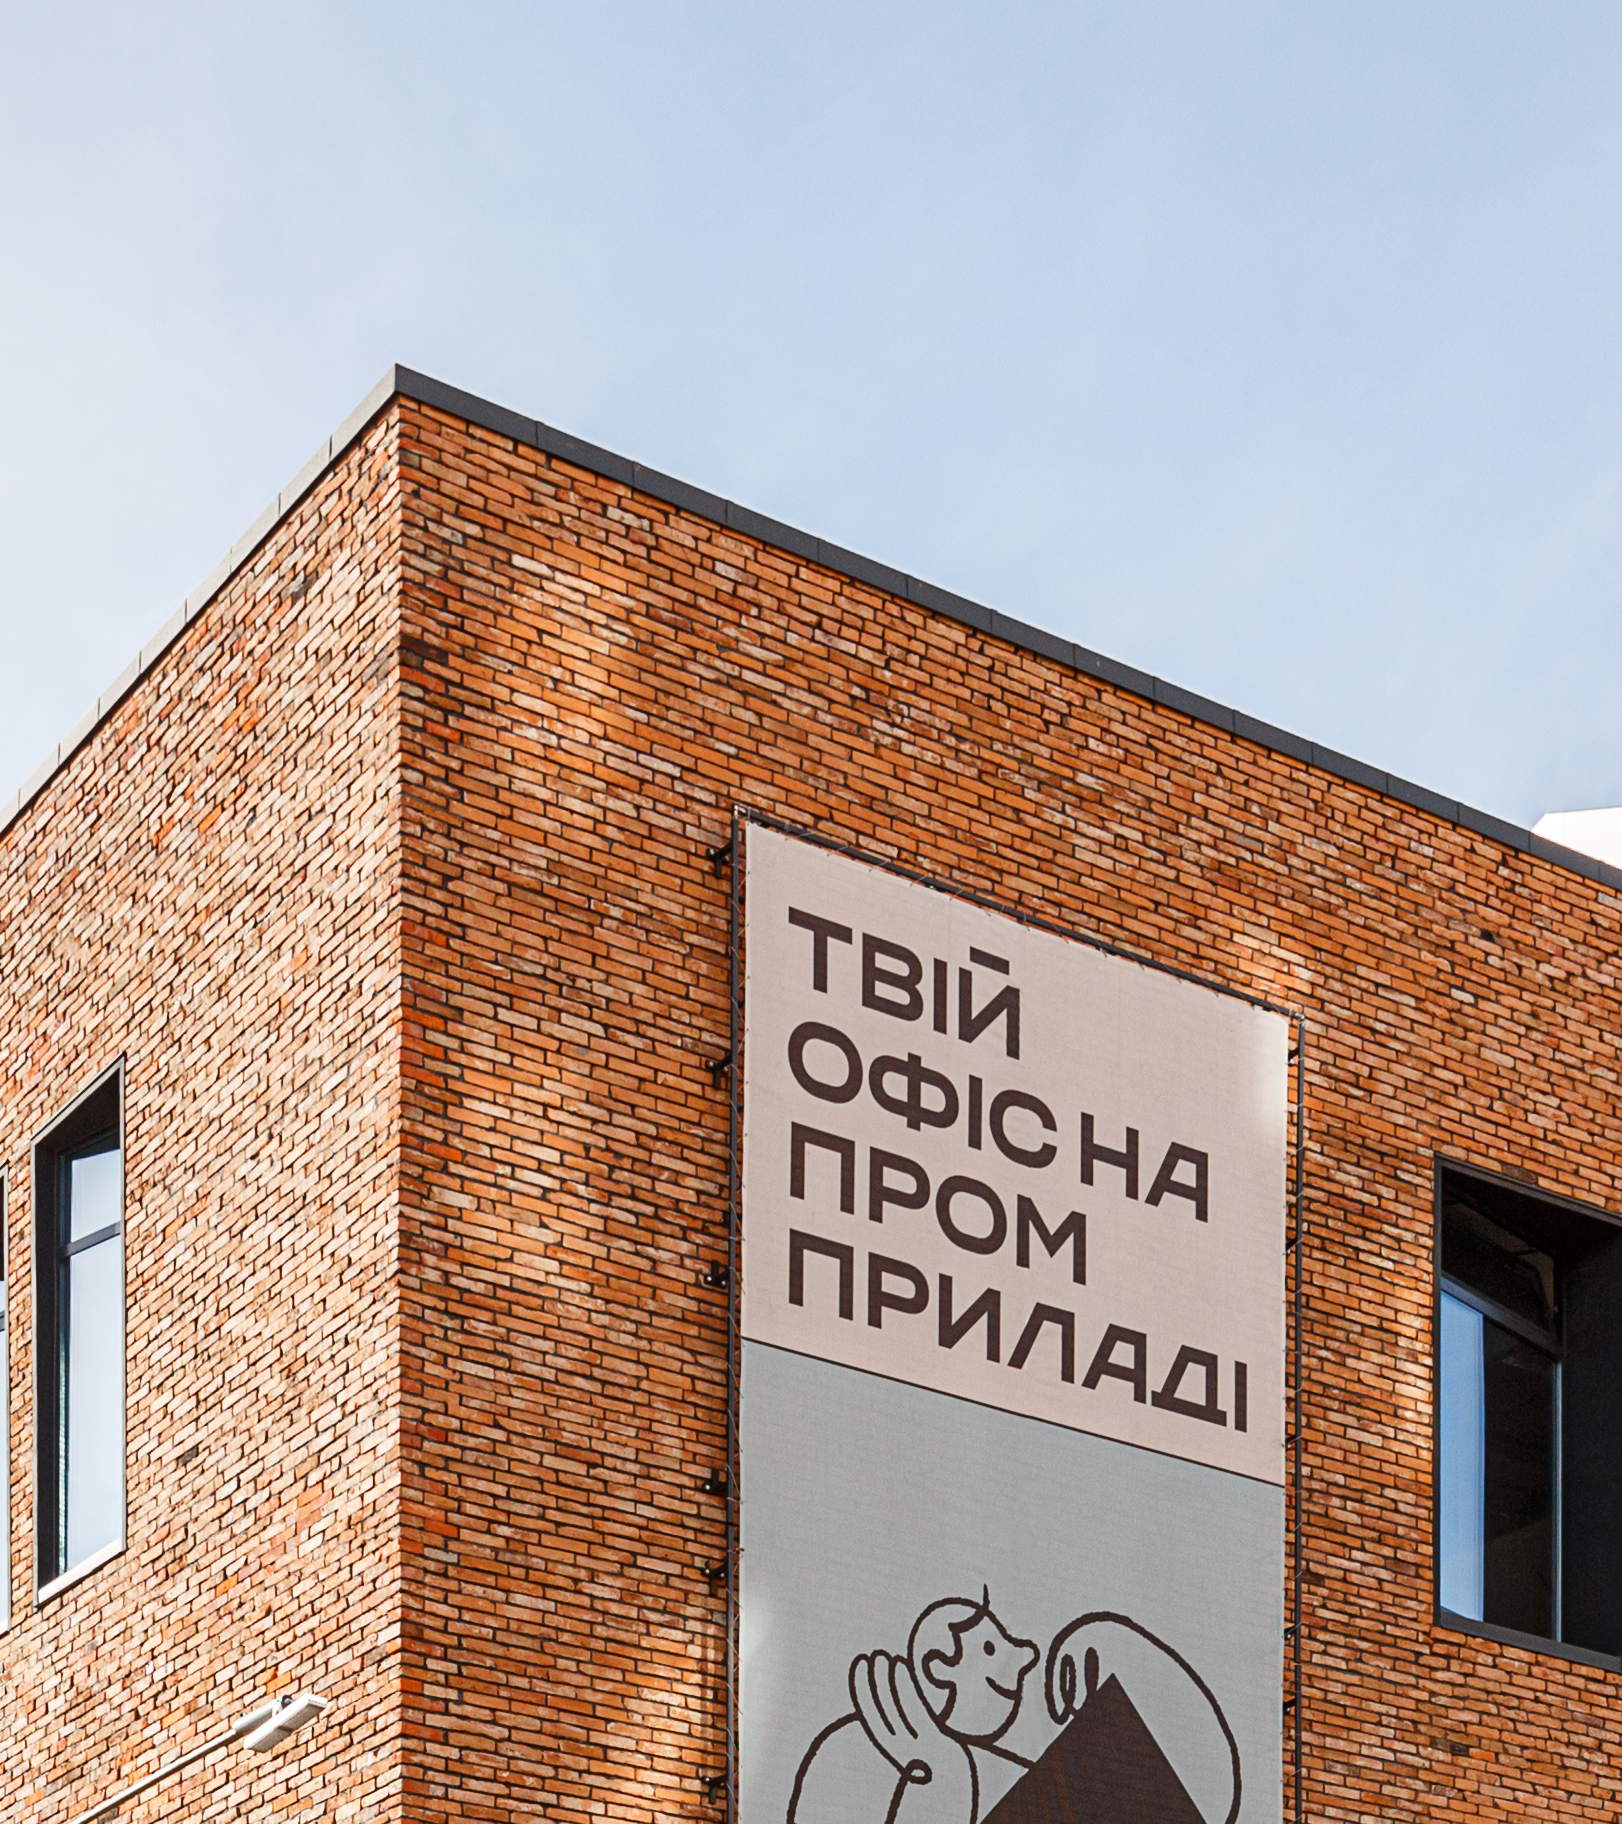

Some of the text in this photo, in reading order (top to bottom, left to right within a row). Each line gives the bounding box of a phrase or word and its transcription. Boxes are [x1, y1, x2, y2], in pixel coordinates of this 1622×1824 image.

[788, 906, 1021, 1060] ТВІЙ
[788, 1022, 1209, 1223] ОФІС НА
[789, 1121, 1087, 1286] ПРОМ
[788, 1228, 1248, 1433] ПРИЛАДІ
